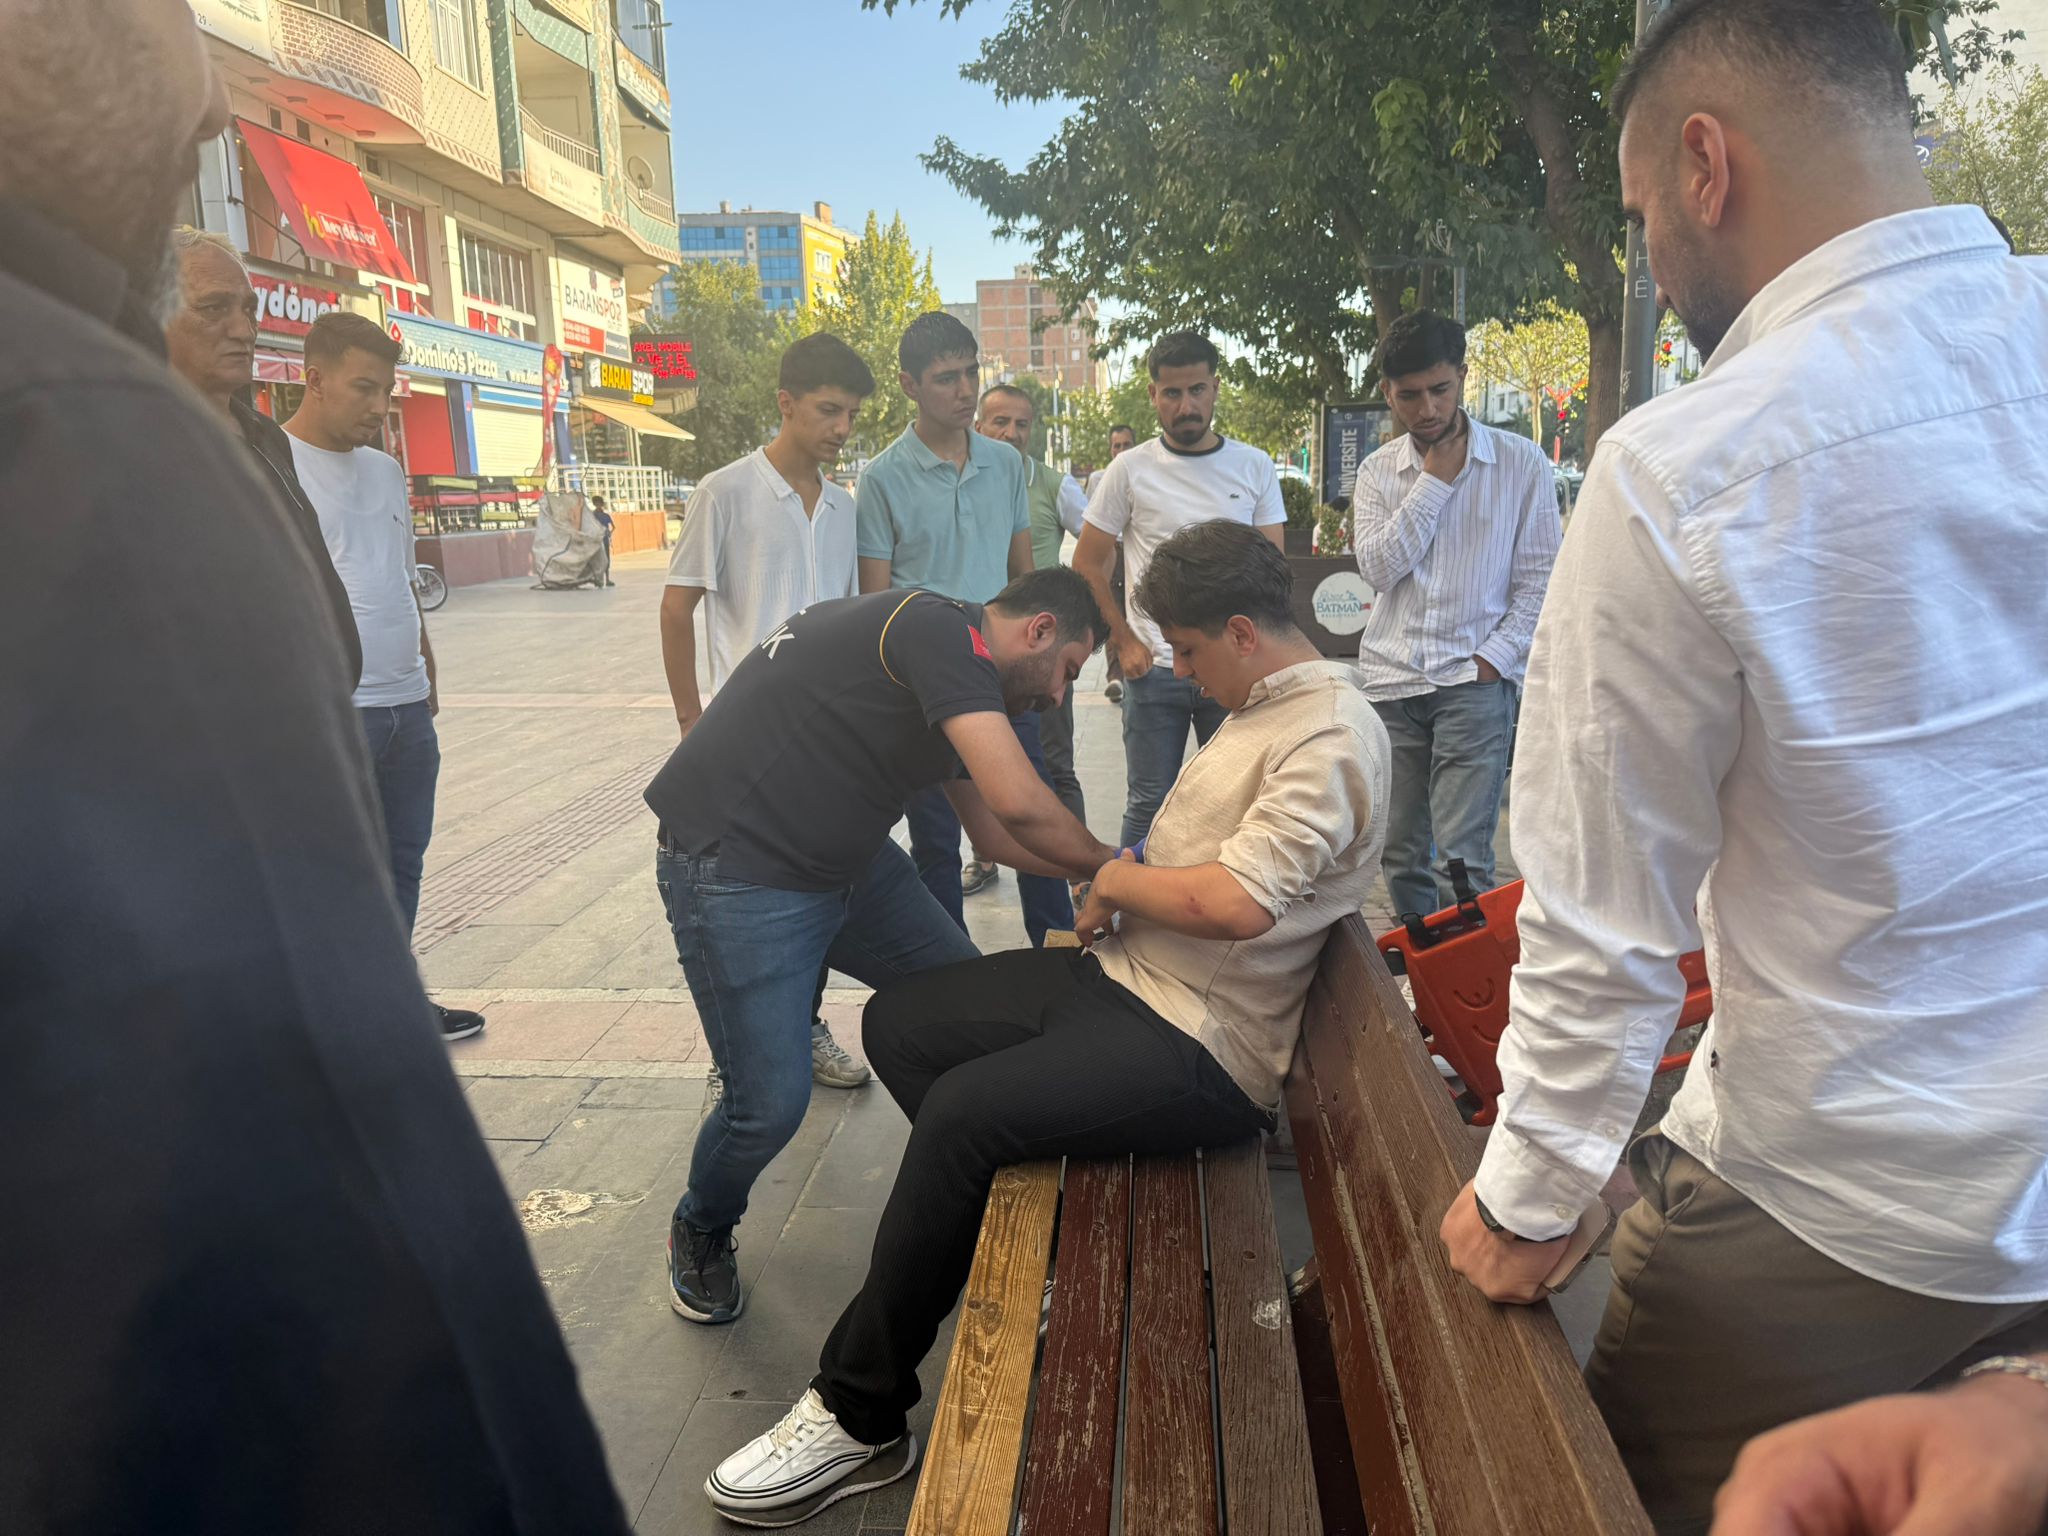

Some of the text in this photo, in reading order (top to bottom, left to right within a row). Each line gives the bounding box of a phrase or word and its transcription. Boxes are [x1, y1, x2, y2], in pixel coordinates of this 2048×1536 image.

[404, 338, 467, 374] Domino's
[466, 350, 499, 379] Pizza
[601, 361, 632, 392] BARAN
[632, 369, 654, 396] SPOR
[1316, 601, 1362, 613] BATMAN
